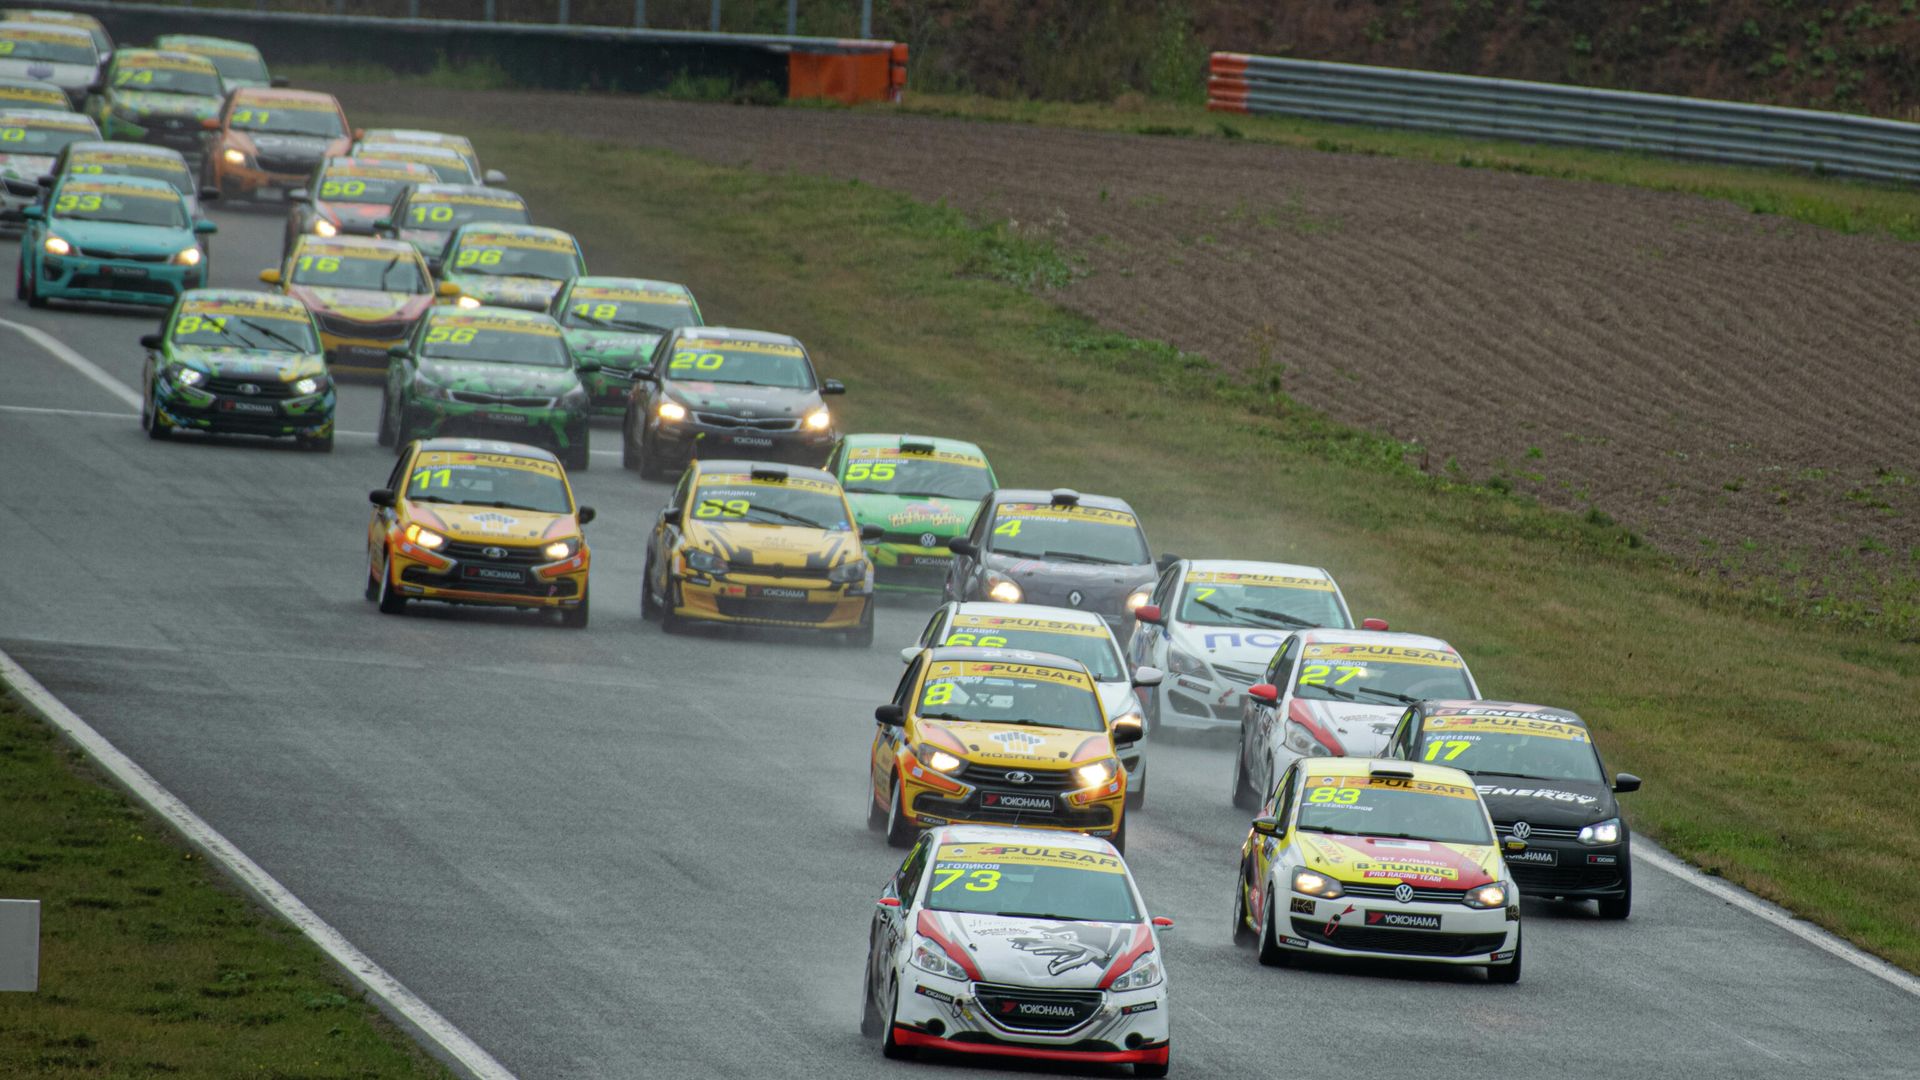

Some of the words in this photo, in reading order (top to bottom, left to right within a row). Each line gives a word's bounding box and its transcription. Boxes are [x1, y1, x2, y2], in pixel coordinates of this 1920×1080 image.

[0, 127, 25, 142] 0
[320, 180, 367, 197] 50
[55, 195, 102, 212] 33
[411, 206, 454, 223] 10
[298, 256, 341, 273] 16
[455, 249, 503, 267] 96
[573, 303, 618, 320] 18
[425, 326, 478, 344] 56
[669, 352, 724, 370] 20
[733, 436, 773, 447] YOKOHAMA
[474, 454, 556, 473] PULSAR
[845, 463, 897, 481] 55
[413, 469, 452, 490] 11
[994, 519, 1022, 537] 4
[479, 568, 521, 580] YOKOHAMA
[1237, 574, 1328, 587] PULSAR
[762, 589, 805, 598] YOKOHAMA
[1195, 588, 1216, 601] 7
[1000, 618, 1096, 632] PULSAR
[945, 633, 1007, 648] 66
[1349, 646, 1458, 664] PULSAR
[990, 664, 1083, 683] PULSAR
[1299, 665, 1361, 685] 27
[923, 683, 955, 706] 8
[1472, 717, 1585, 737] PULSAR
[1424, 740, 1472, 762] 17
[1368, 778, 1466, 795] PULSAR
[1000, 797, 1051, 808] YOKOHAMA
[1309, 787, 1361, 804] 83
[1000, 847, 1118, 867] PULSAR
[932, 869, 1002, 892] 73
[1420, 874, 1442, 882] TEAM
[1385, 914, 1438, 927] YOKOHAMA
[1019, 1004, 1075, 1017] YOKOHAMA
